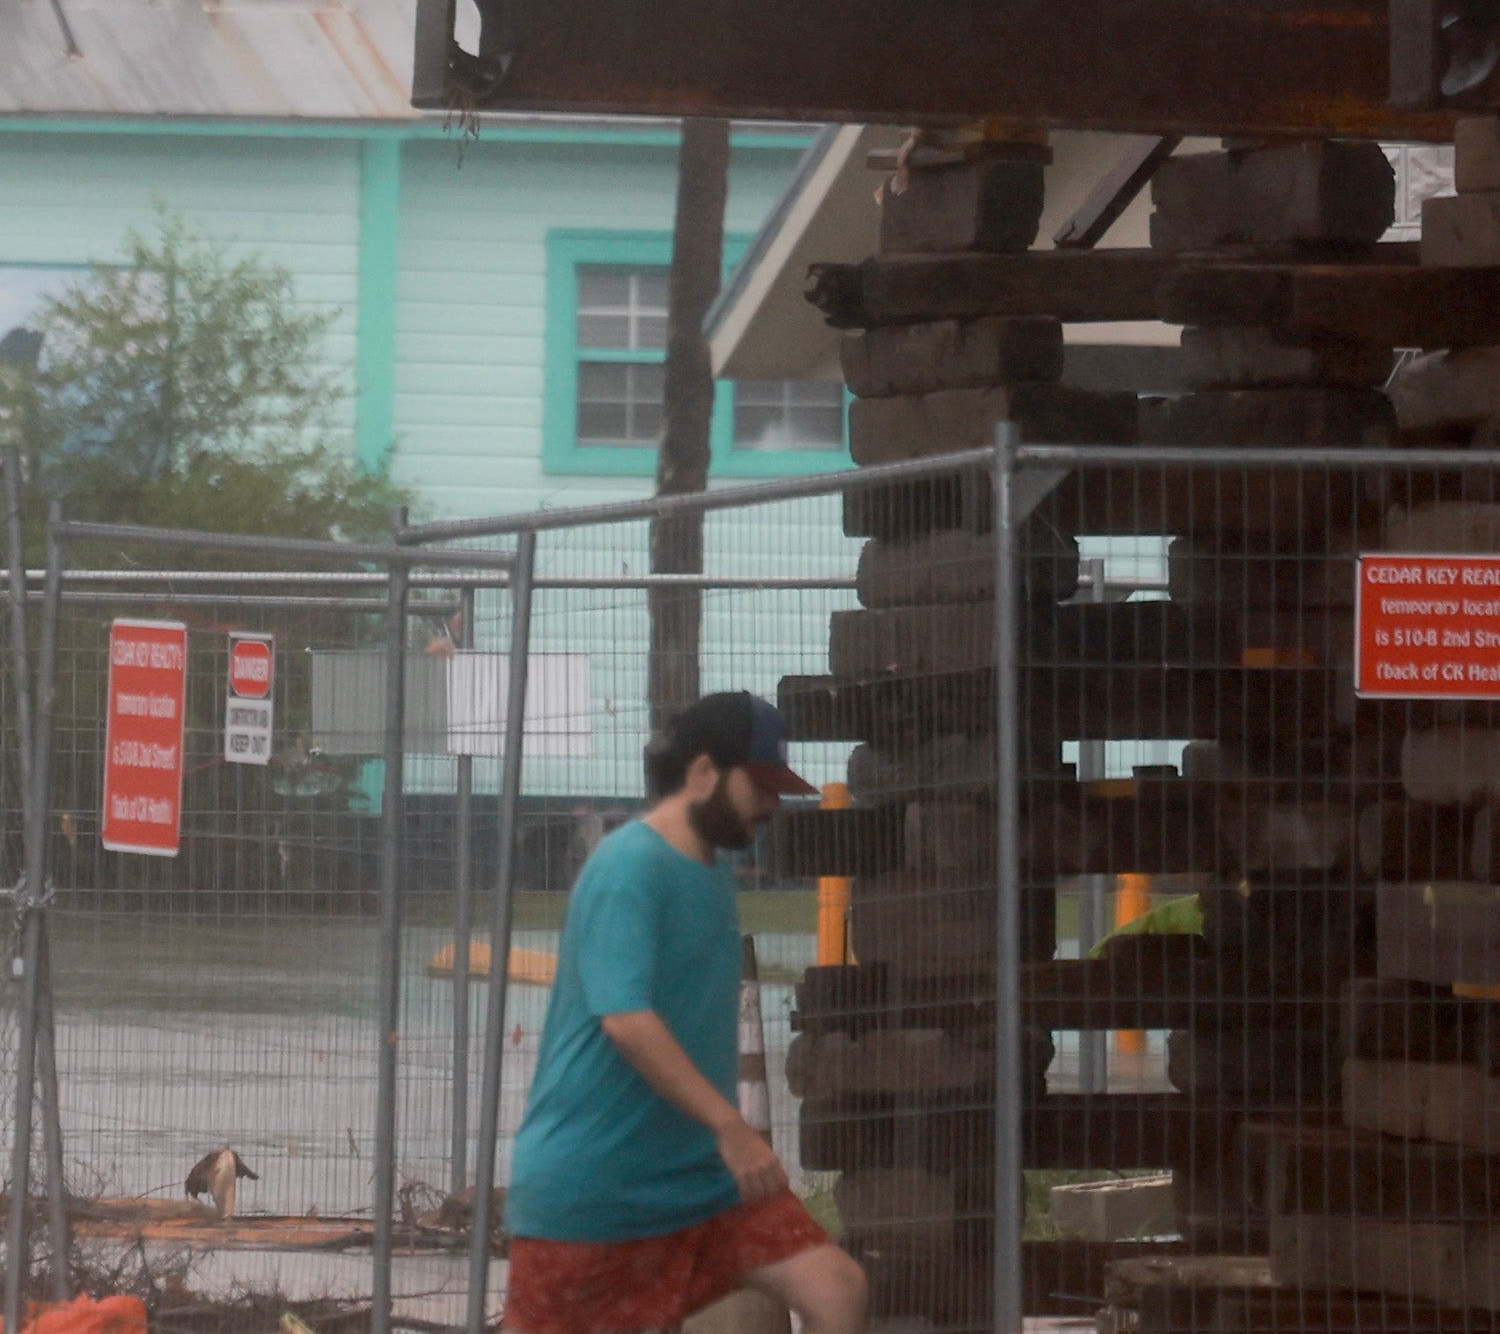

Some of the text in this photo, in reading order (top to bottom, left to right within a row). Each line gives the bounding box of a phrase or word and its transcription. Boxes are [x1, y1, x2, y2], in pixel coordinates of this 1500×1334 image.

[1367, 566, 1422, 584] CEDAR
[1426, 567, 1458, 585] KEY
[1381, 598, 1459, 616] temporary
[1375, 629, 1390, 646] is
[1442, 630, 1470, 647] 2nd
[1376, 663, 1419, 681] (back
[1422, 664, 1439, 680] of
[1441, 664, 1465, 681] CK
